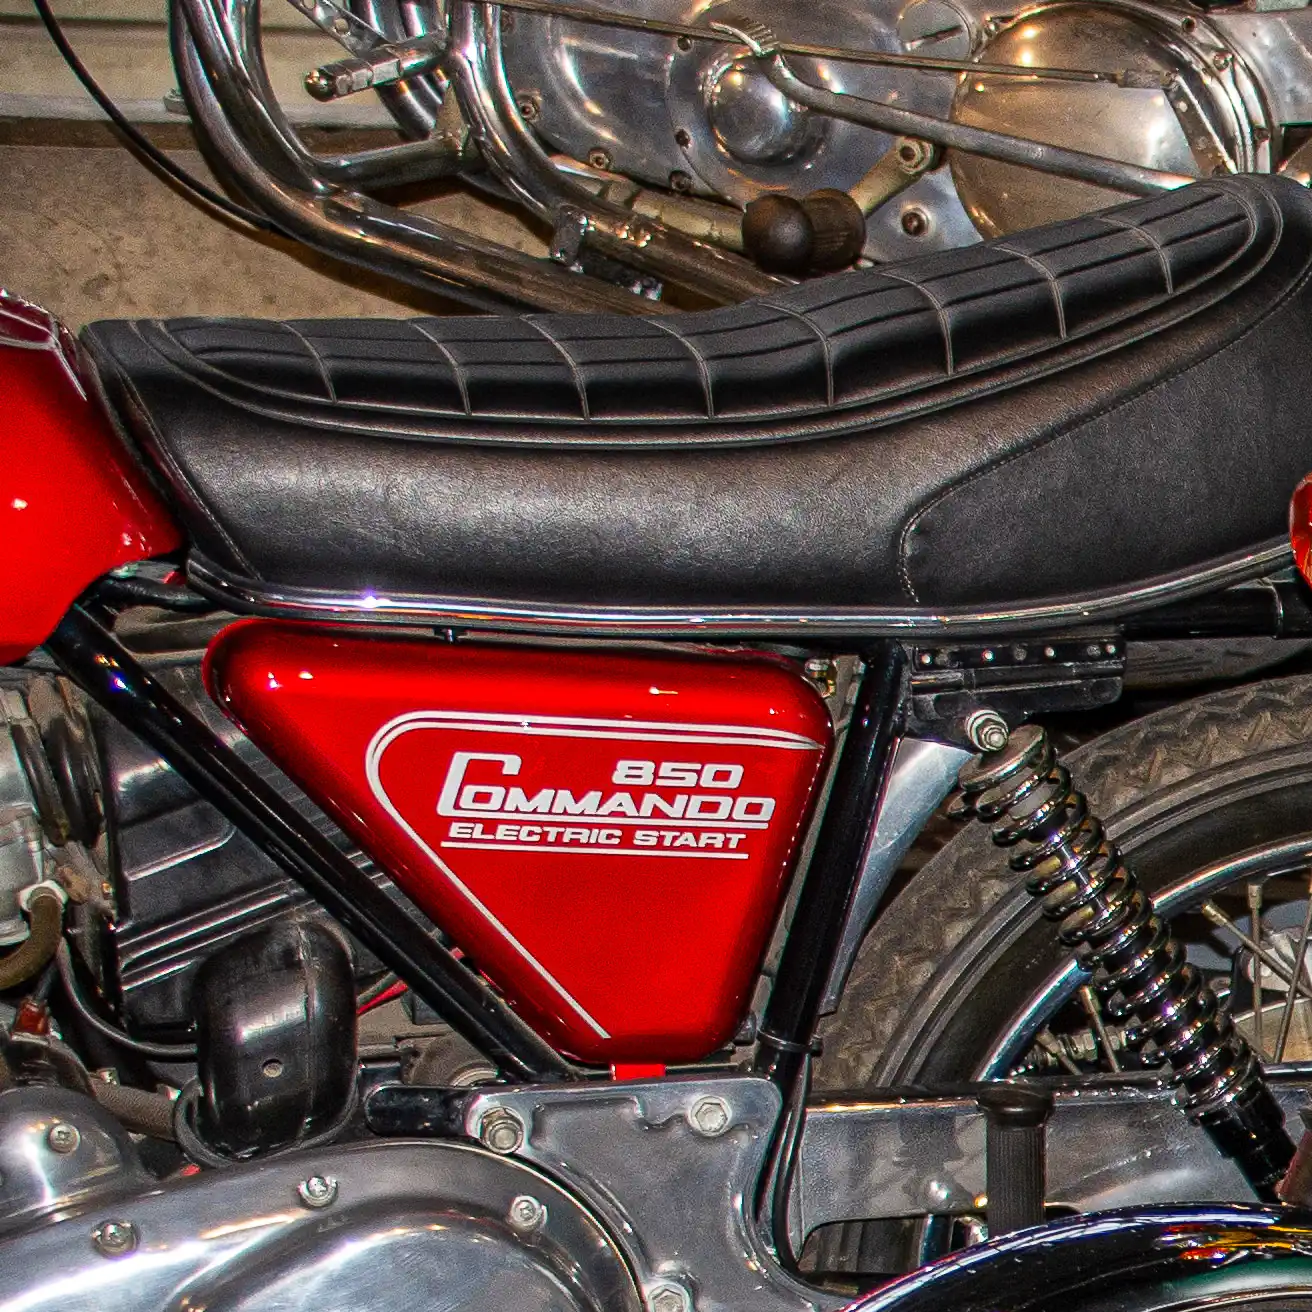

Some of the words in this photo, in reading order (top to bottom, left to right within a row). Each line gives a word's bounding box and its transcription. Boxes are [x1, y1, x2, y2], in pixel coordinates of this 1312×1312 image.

[436, 751, 776, 823] COMMANDO
[611, 760, 744, 789] 850
[448, 822, 623, 845] ELECTRIC
[632, 829, 747, 849] START
